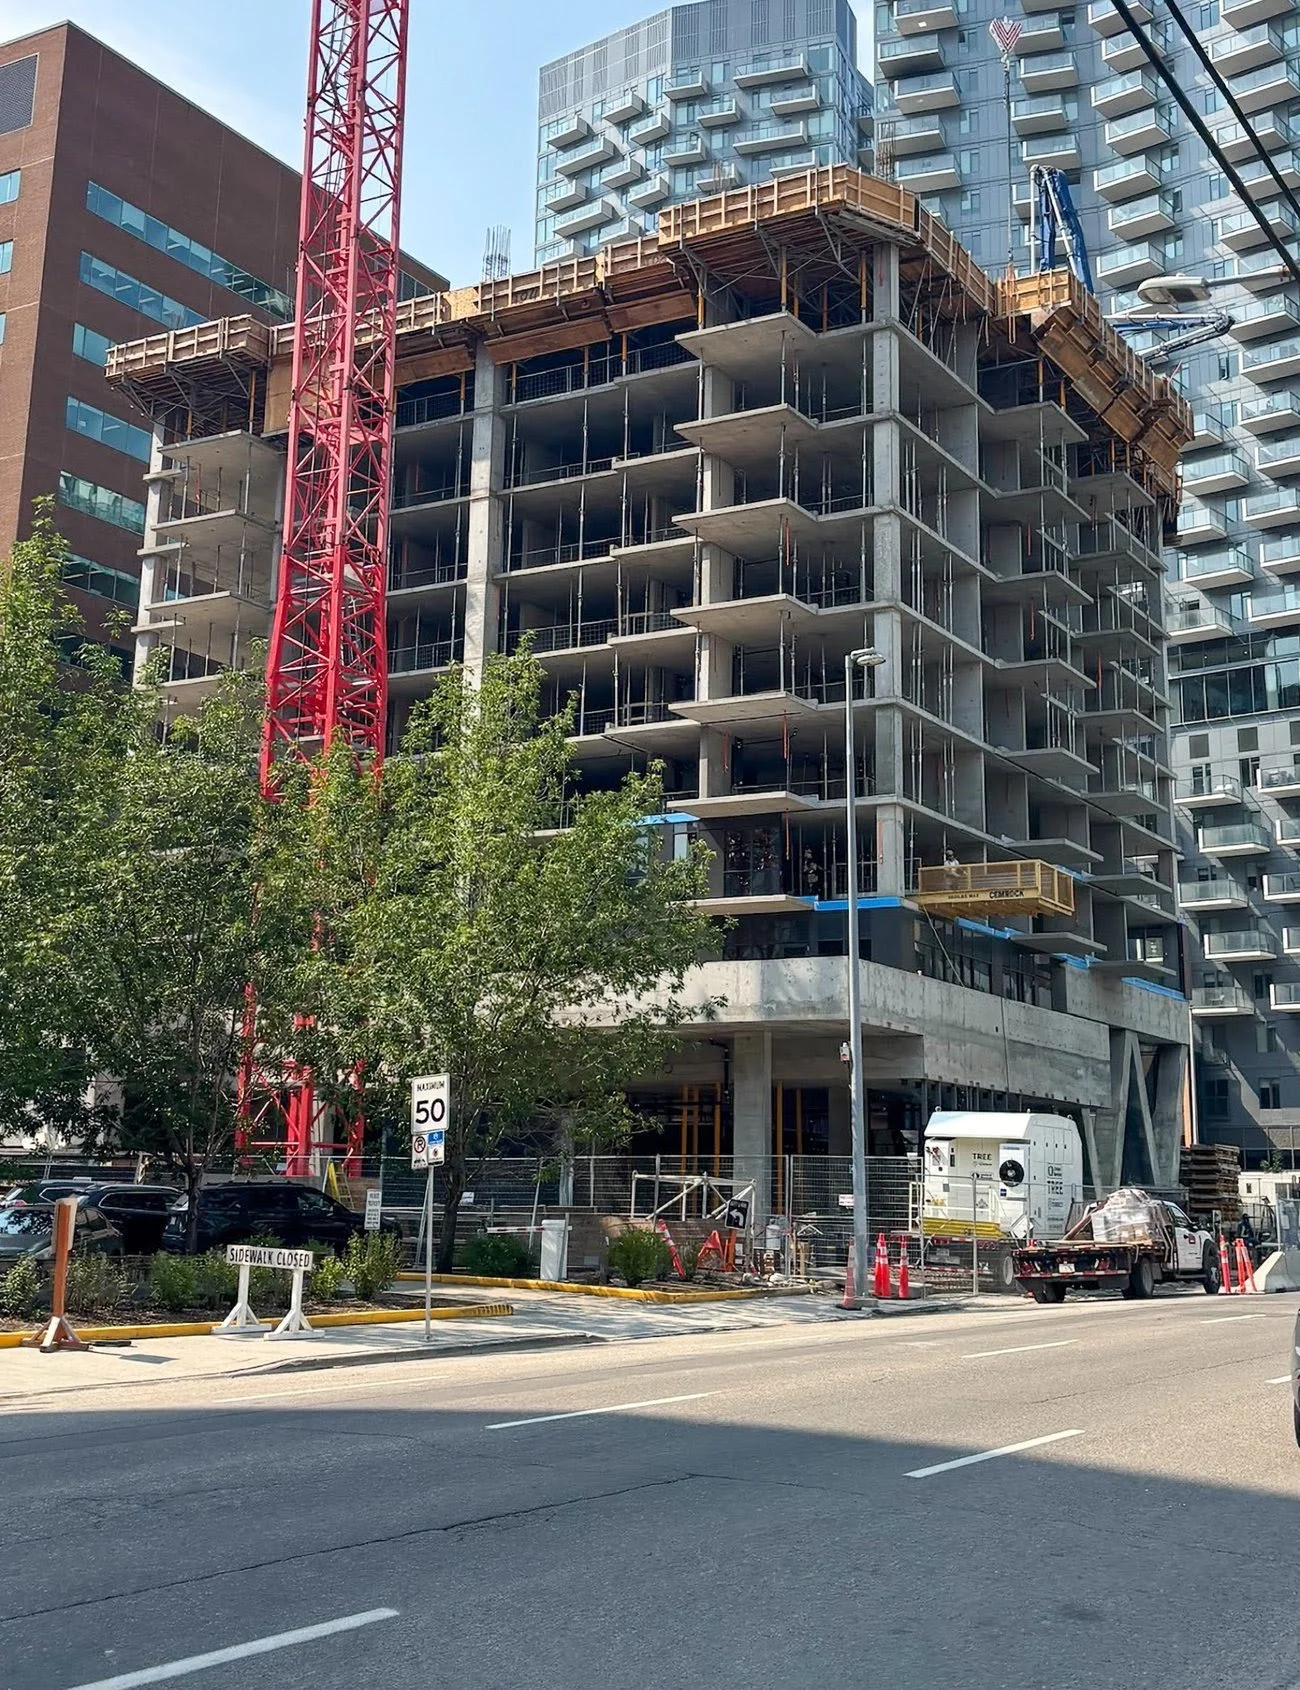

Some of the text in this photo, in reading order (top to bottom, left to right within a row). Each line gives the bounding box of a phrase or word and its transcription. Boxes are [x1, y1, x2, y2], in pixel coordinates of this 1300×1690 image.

[416, 1080, 445, 1092] MAXIMUM
[415, 1098, 445, 1124] 50
[229, 1247, 310, 1267] SIDEWALK CLOSED
